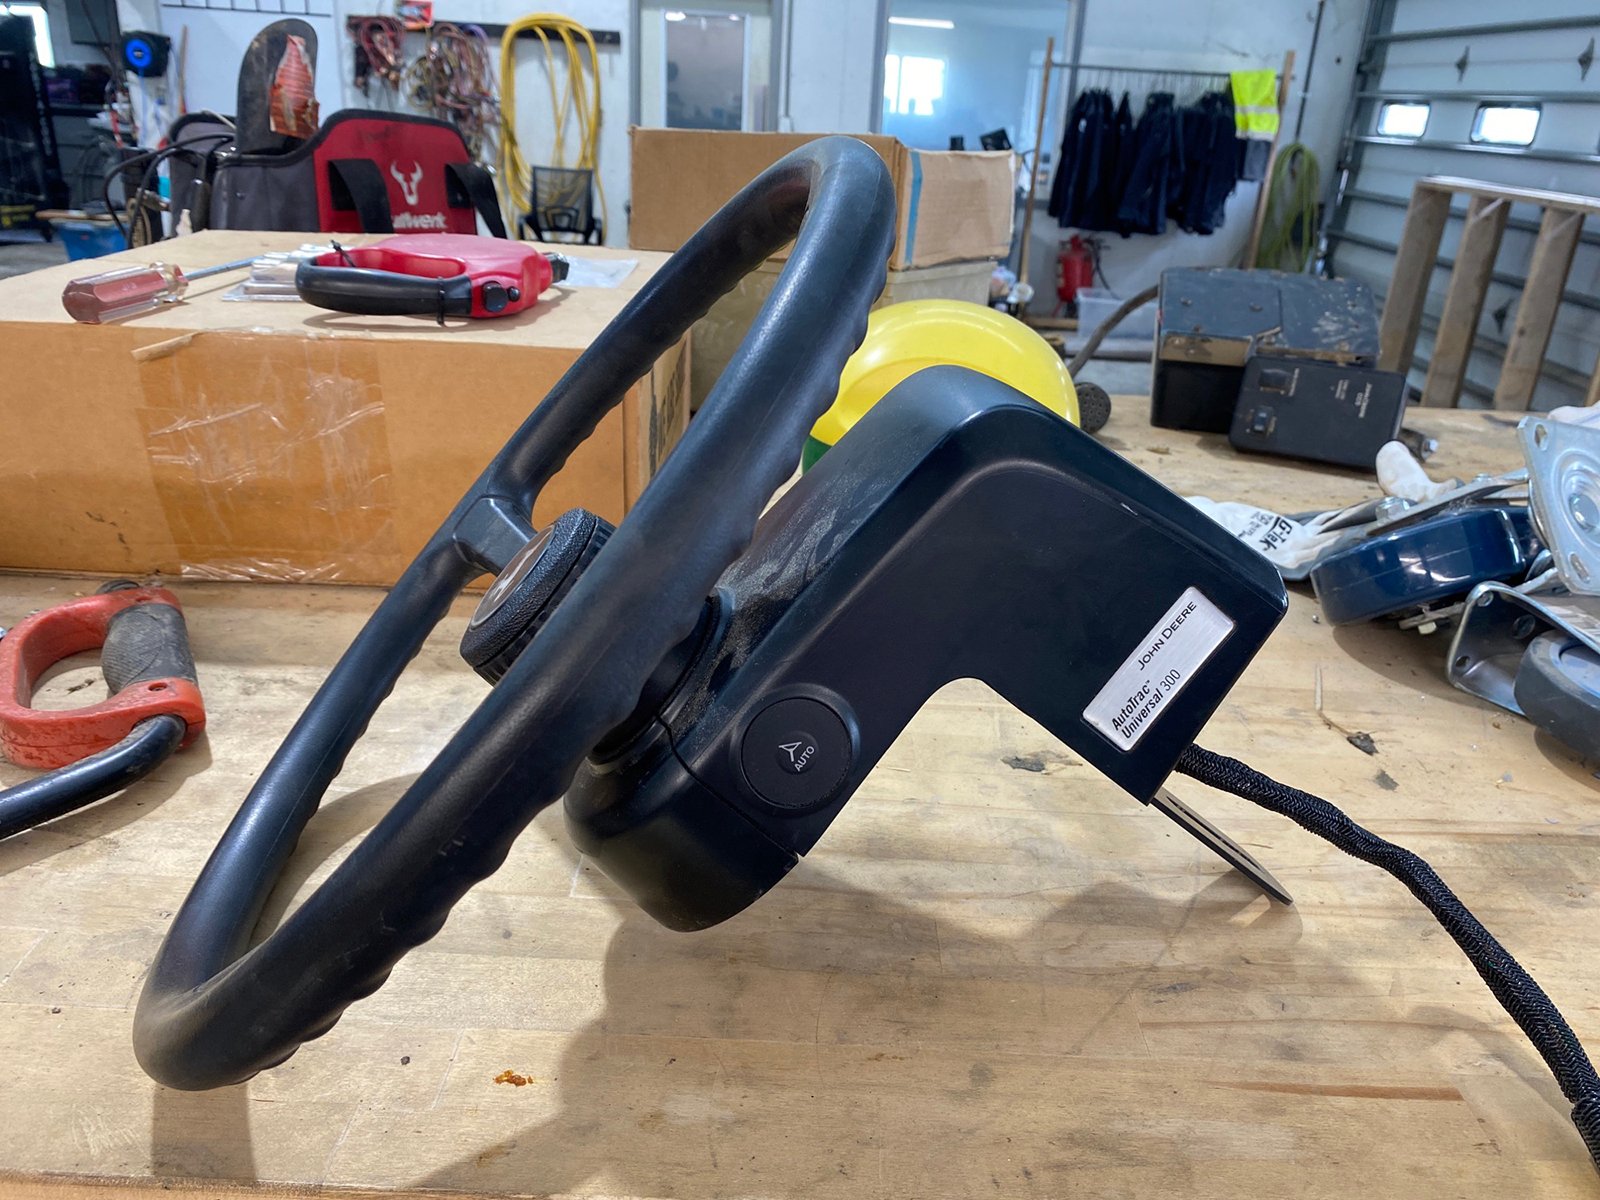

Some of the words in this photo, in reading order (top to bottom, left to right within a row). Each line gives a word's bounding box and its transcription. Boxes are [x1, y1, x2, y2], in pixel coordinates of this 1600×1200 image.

[392, 211, 448, 229] ullwerk
[1259, 519, 1293, 551] G-Tek
[1138, 640, 1165, 671] JOHN
[1161, 602, 1197, 639] DEERE
[1121, 689, 1163, 739] Universal
[1160, 669, 1181, 691] 300
[794, 745, 815, 772] AUTO
